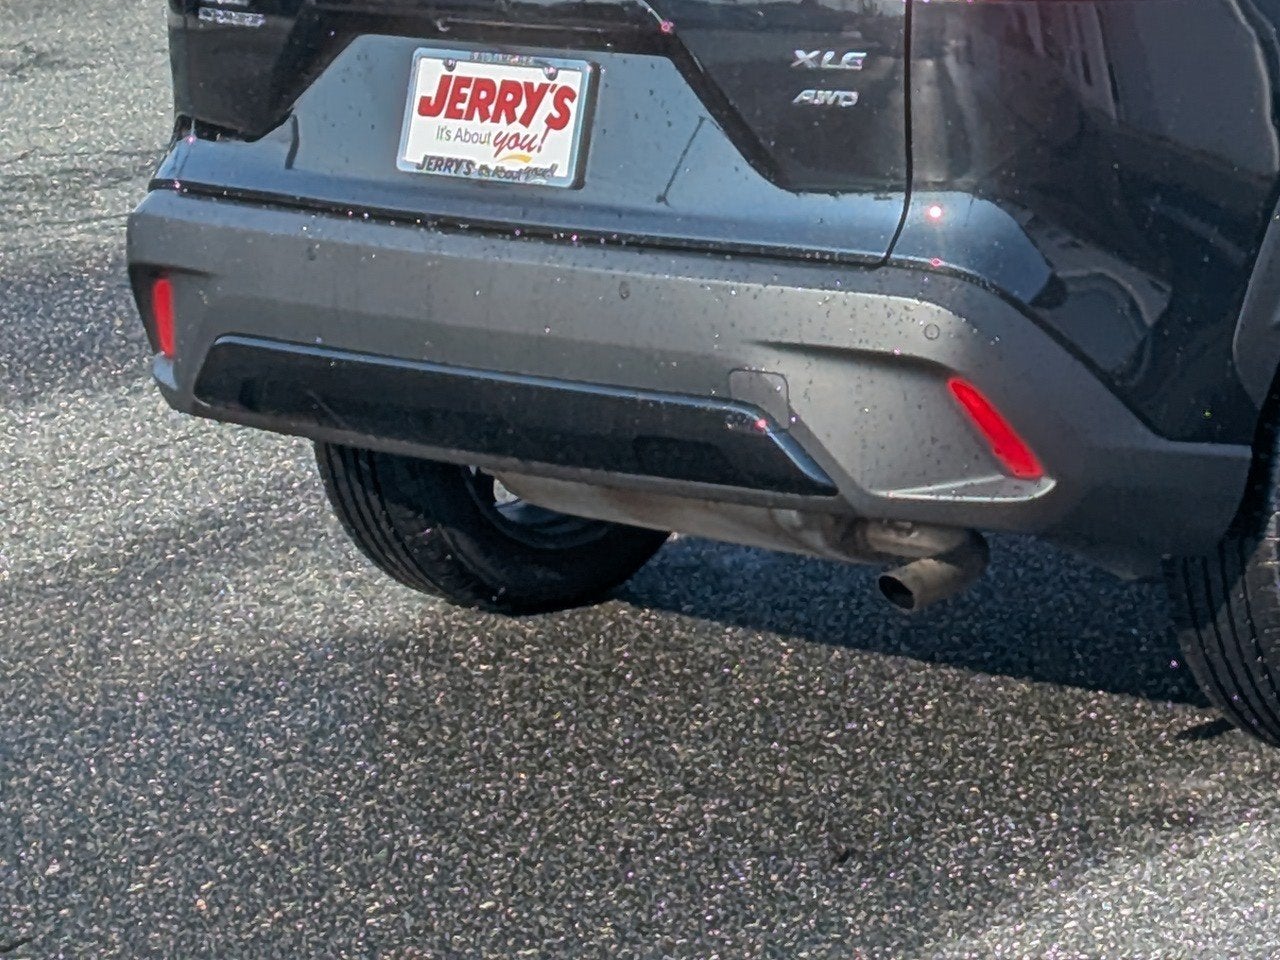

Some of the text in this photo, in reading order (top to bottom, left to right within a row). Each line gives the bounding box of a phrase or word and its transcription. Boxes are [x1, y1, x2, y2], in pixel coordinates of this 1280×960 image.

[790, 49, 867, 70] XLE
[418, 74, 577, 131] JERRY'S
[792, 89, 859, 108] AWD
[436, 125, 551, 158] It's About you!
[416, 154, 475, 176] JERRY'S
